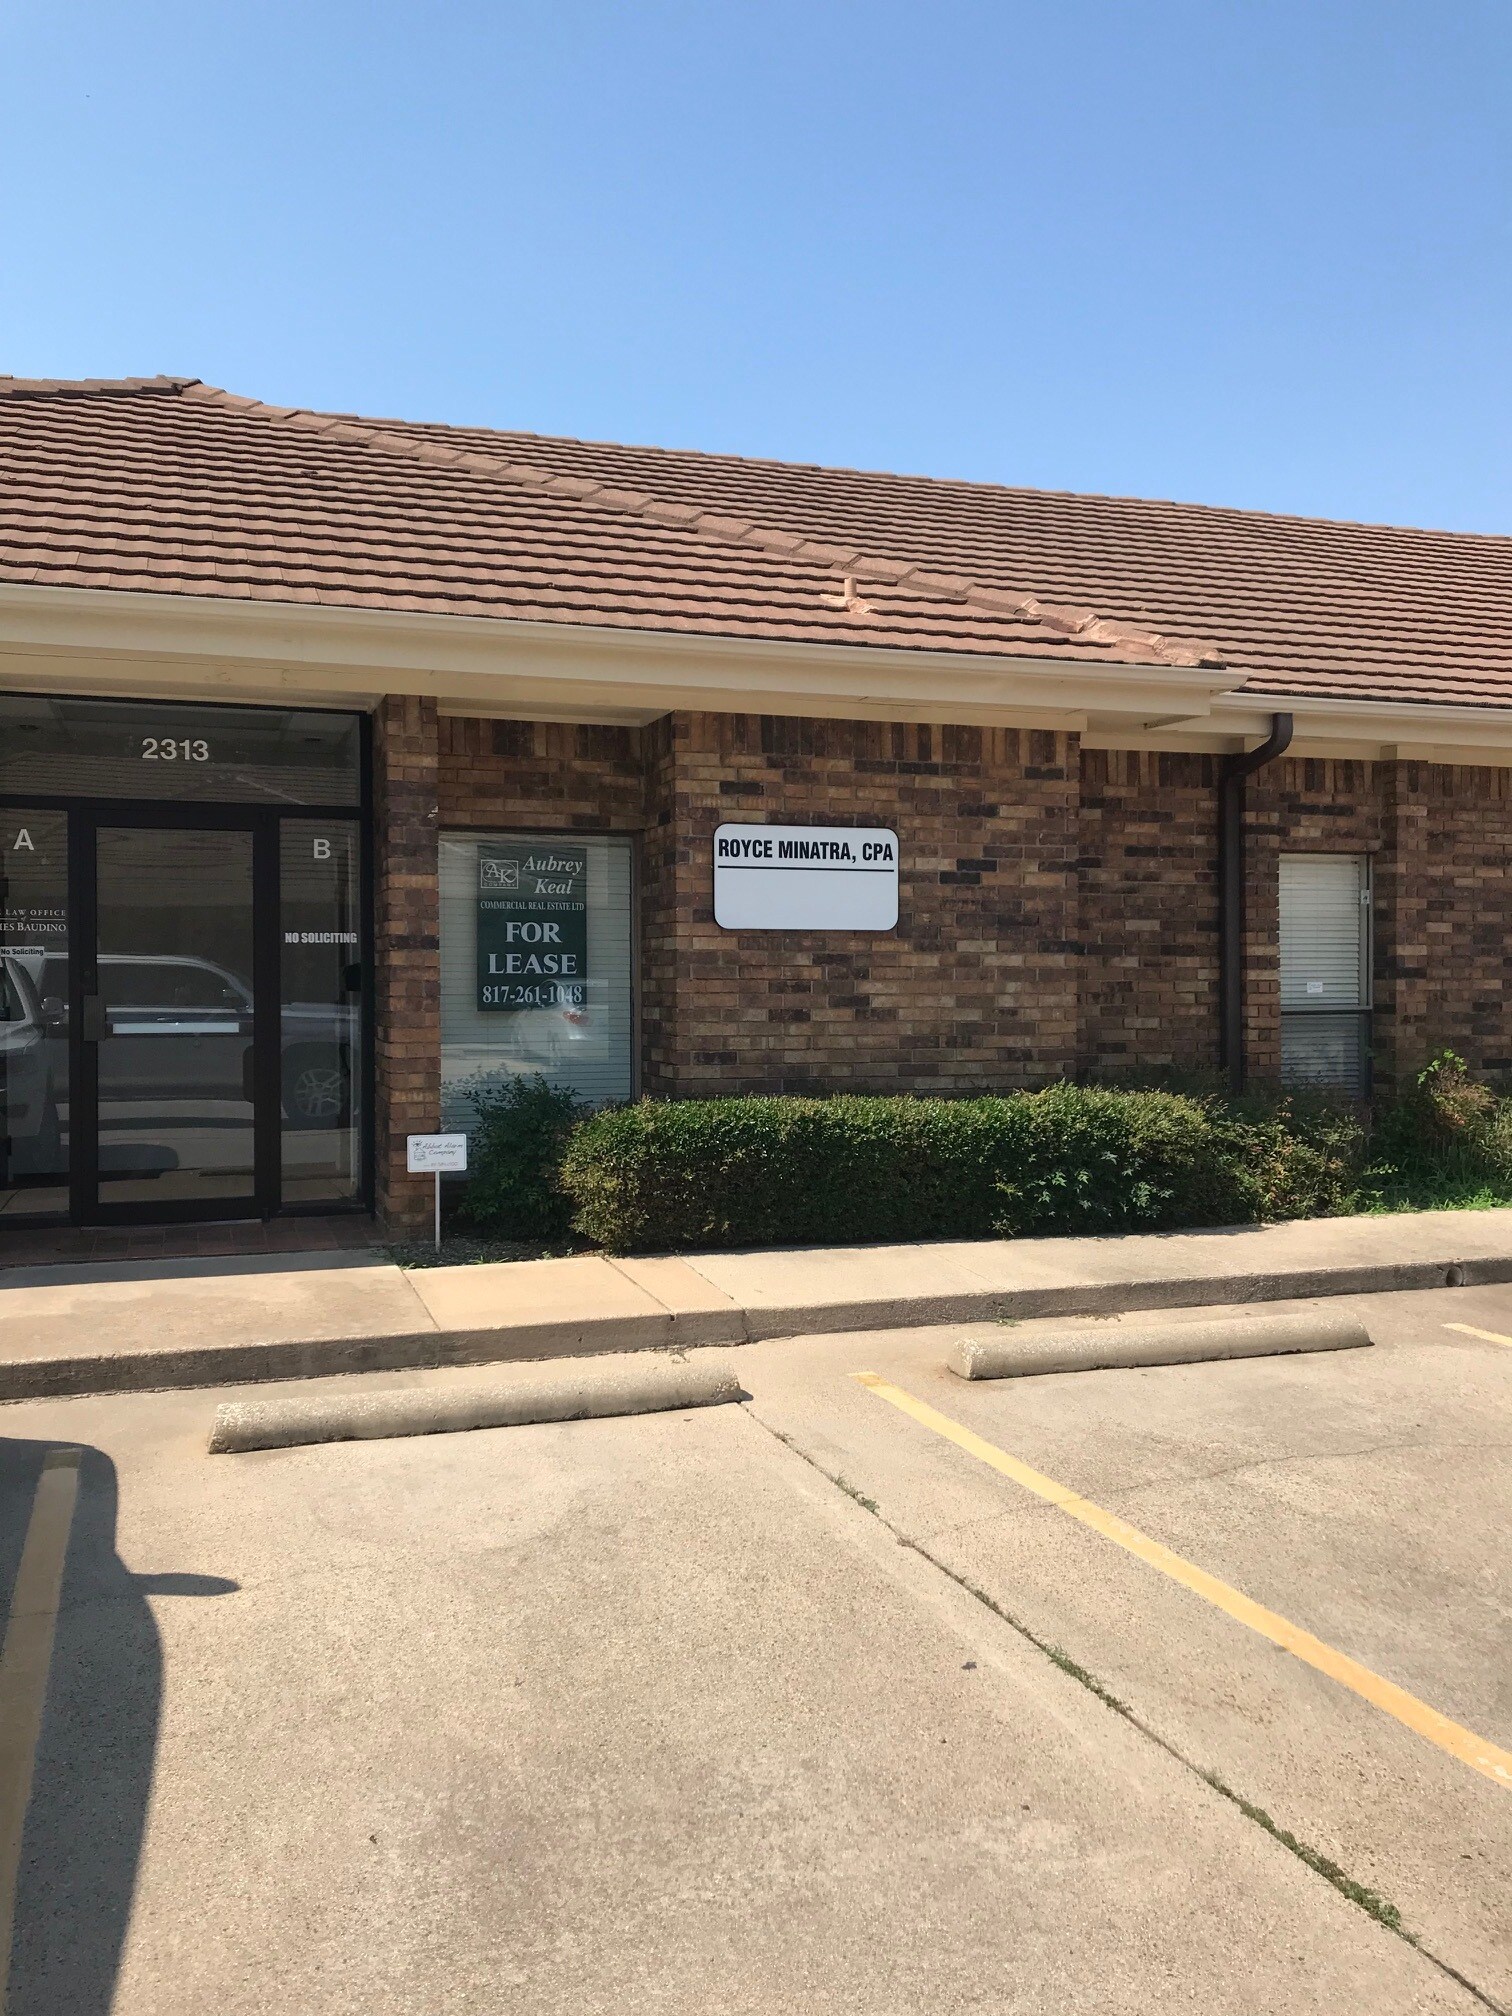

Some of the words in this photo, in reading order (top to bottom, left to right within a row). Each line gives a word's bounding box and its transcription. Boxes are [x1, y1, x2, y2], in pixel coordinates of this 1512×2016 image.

[142, 738, 209, 761] 2313
[13, 829, 34, 850] A
[313, 839, 331, 859] B
[718, 838, 773, 858] ROYCE
[778, 840, 857, 863] MINATRA,
[862, 842, 894, 861] CPA
[522, 856, 583, 876] Aubrey
[534, 878, 572, 895] Keal
[480, 901, 527, 910] COMMERCIAL
[528, 902, 546, 910] REAL
[547, 902, 571, 911] ESTATE
[572, 902, 585, 911] LTD
[0, 922, 15, 931] ES
[505, 921, 563, 943] FOR
[285, 932, 300, 943] NO
[301, 932, 358, 944] SOLICITING
[12, 948, 44, 956] Soliciting
[488, 953, 578, 975] LEASE
[482, 985, 583, 1003] 817-261-1048
